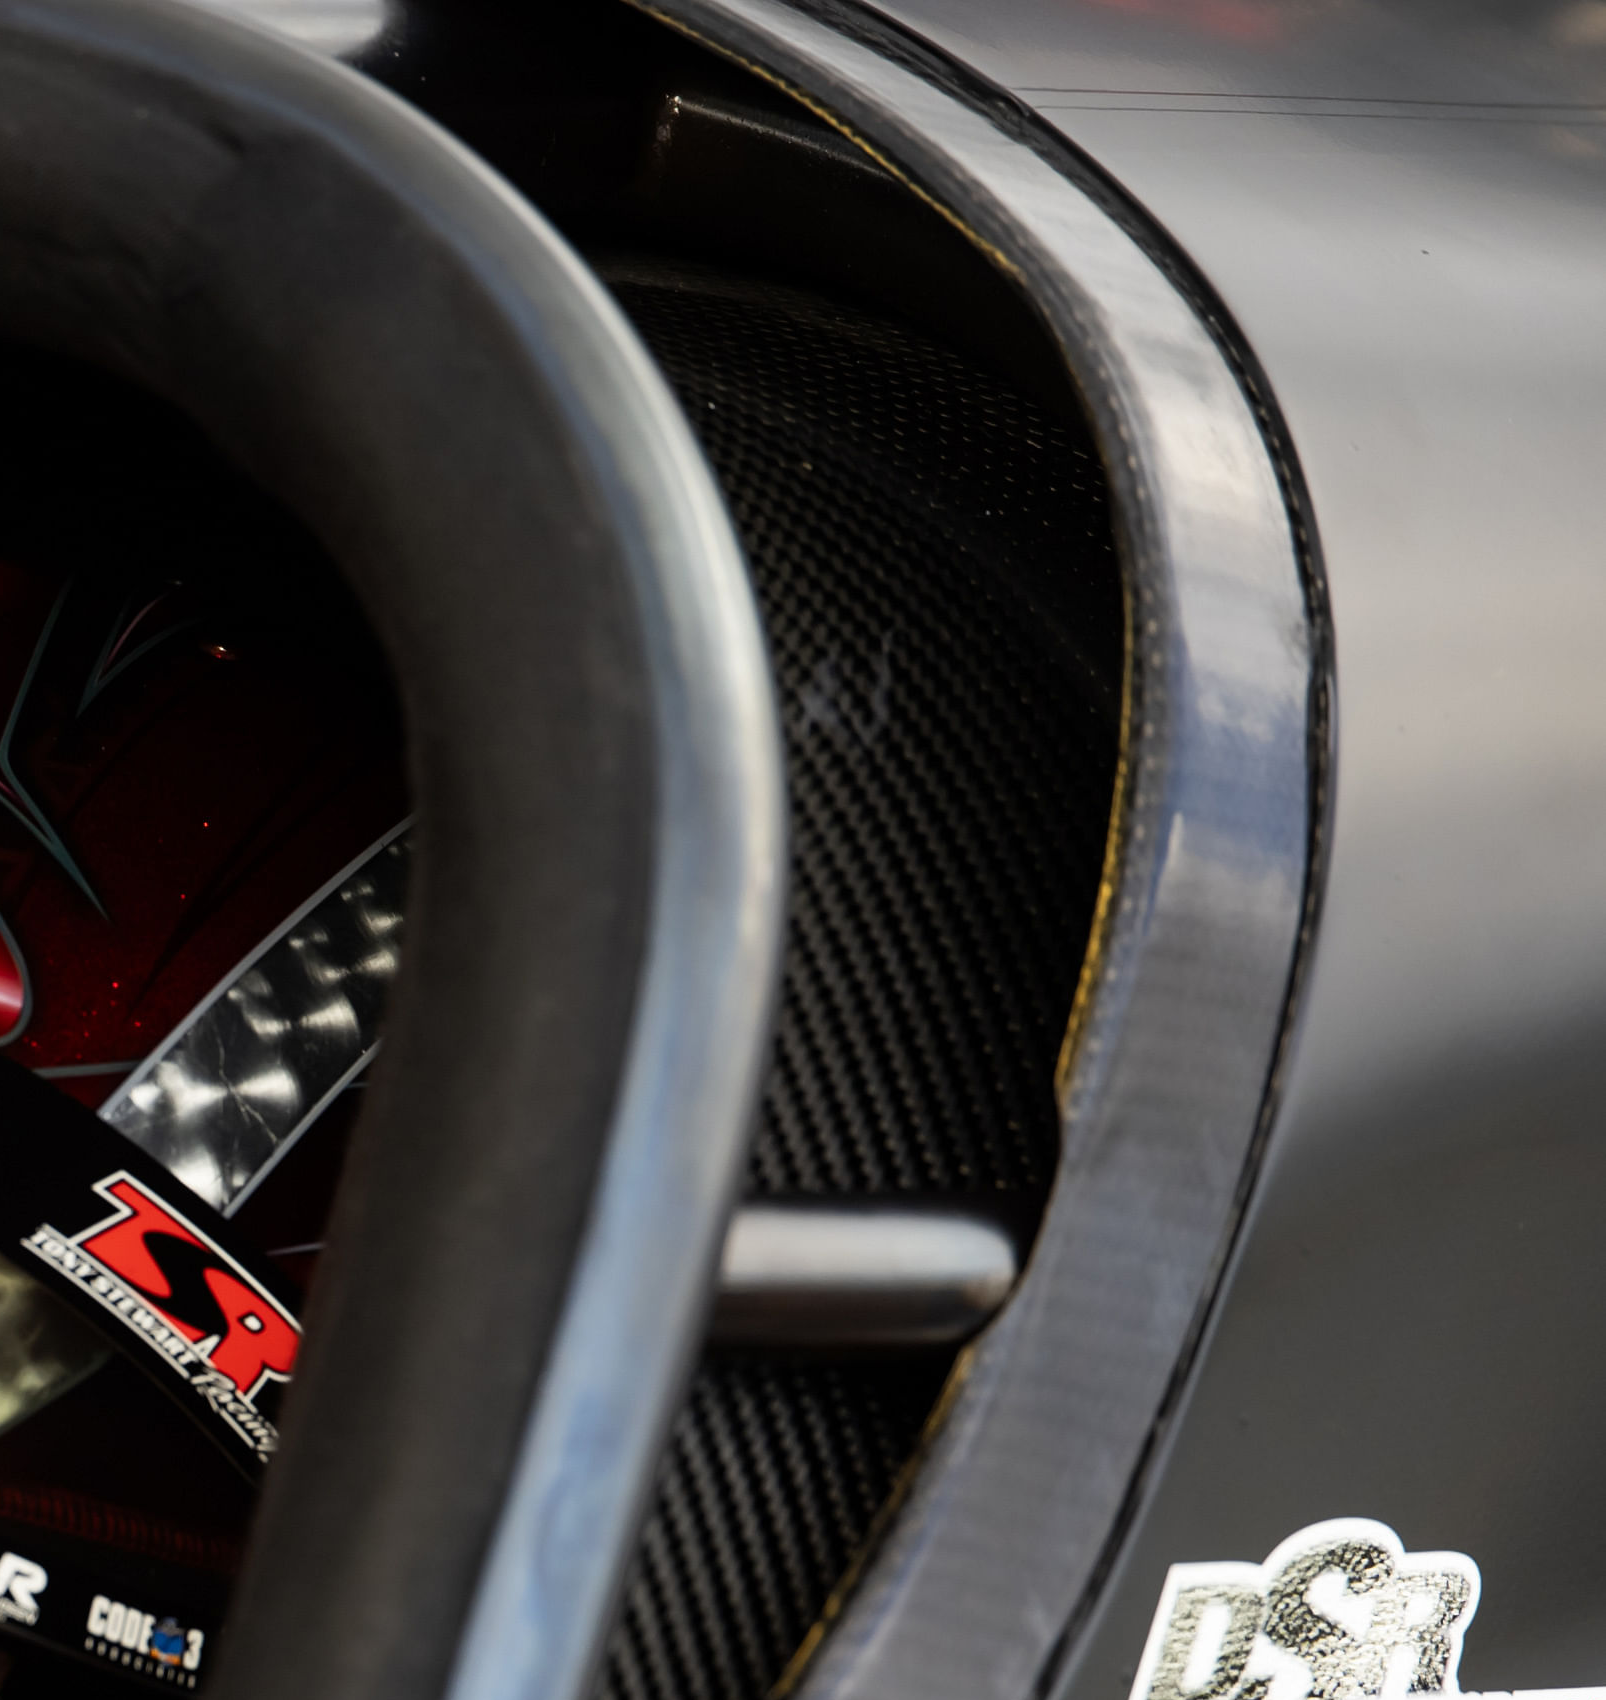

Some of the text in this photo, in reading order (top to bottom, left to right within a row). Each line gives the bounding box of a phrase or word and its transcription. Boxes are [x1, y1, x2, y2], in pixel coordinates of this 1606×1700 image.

[27, 1229, 101, 1279] TONY
[90, 1274, 199, 1366] STEWART
[86, 1593, 157, 1655] CODE
[182, 1628, 205, 1671] 3
